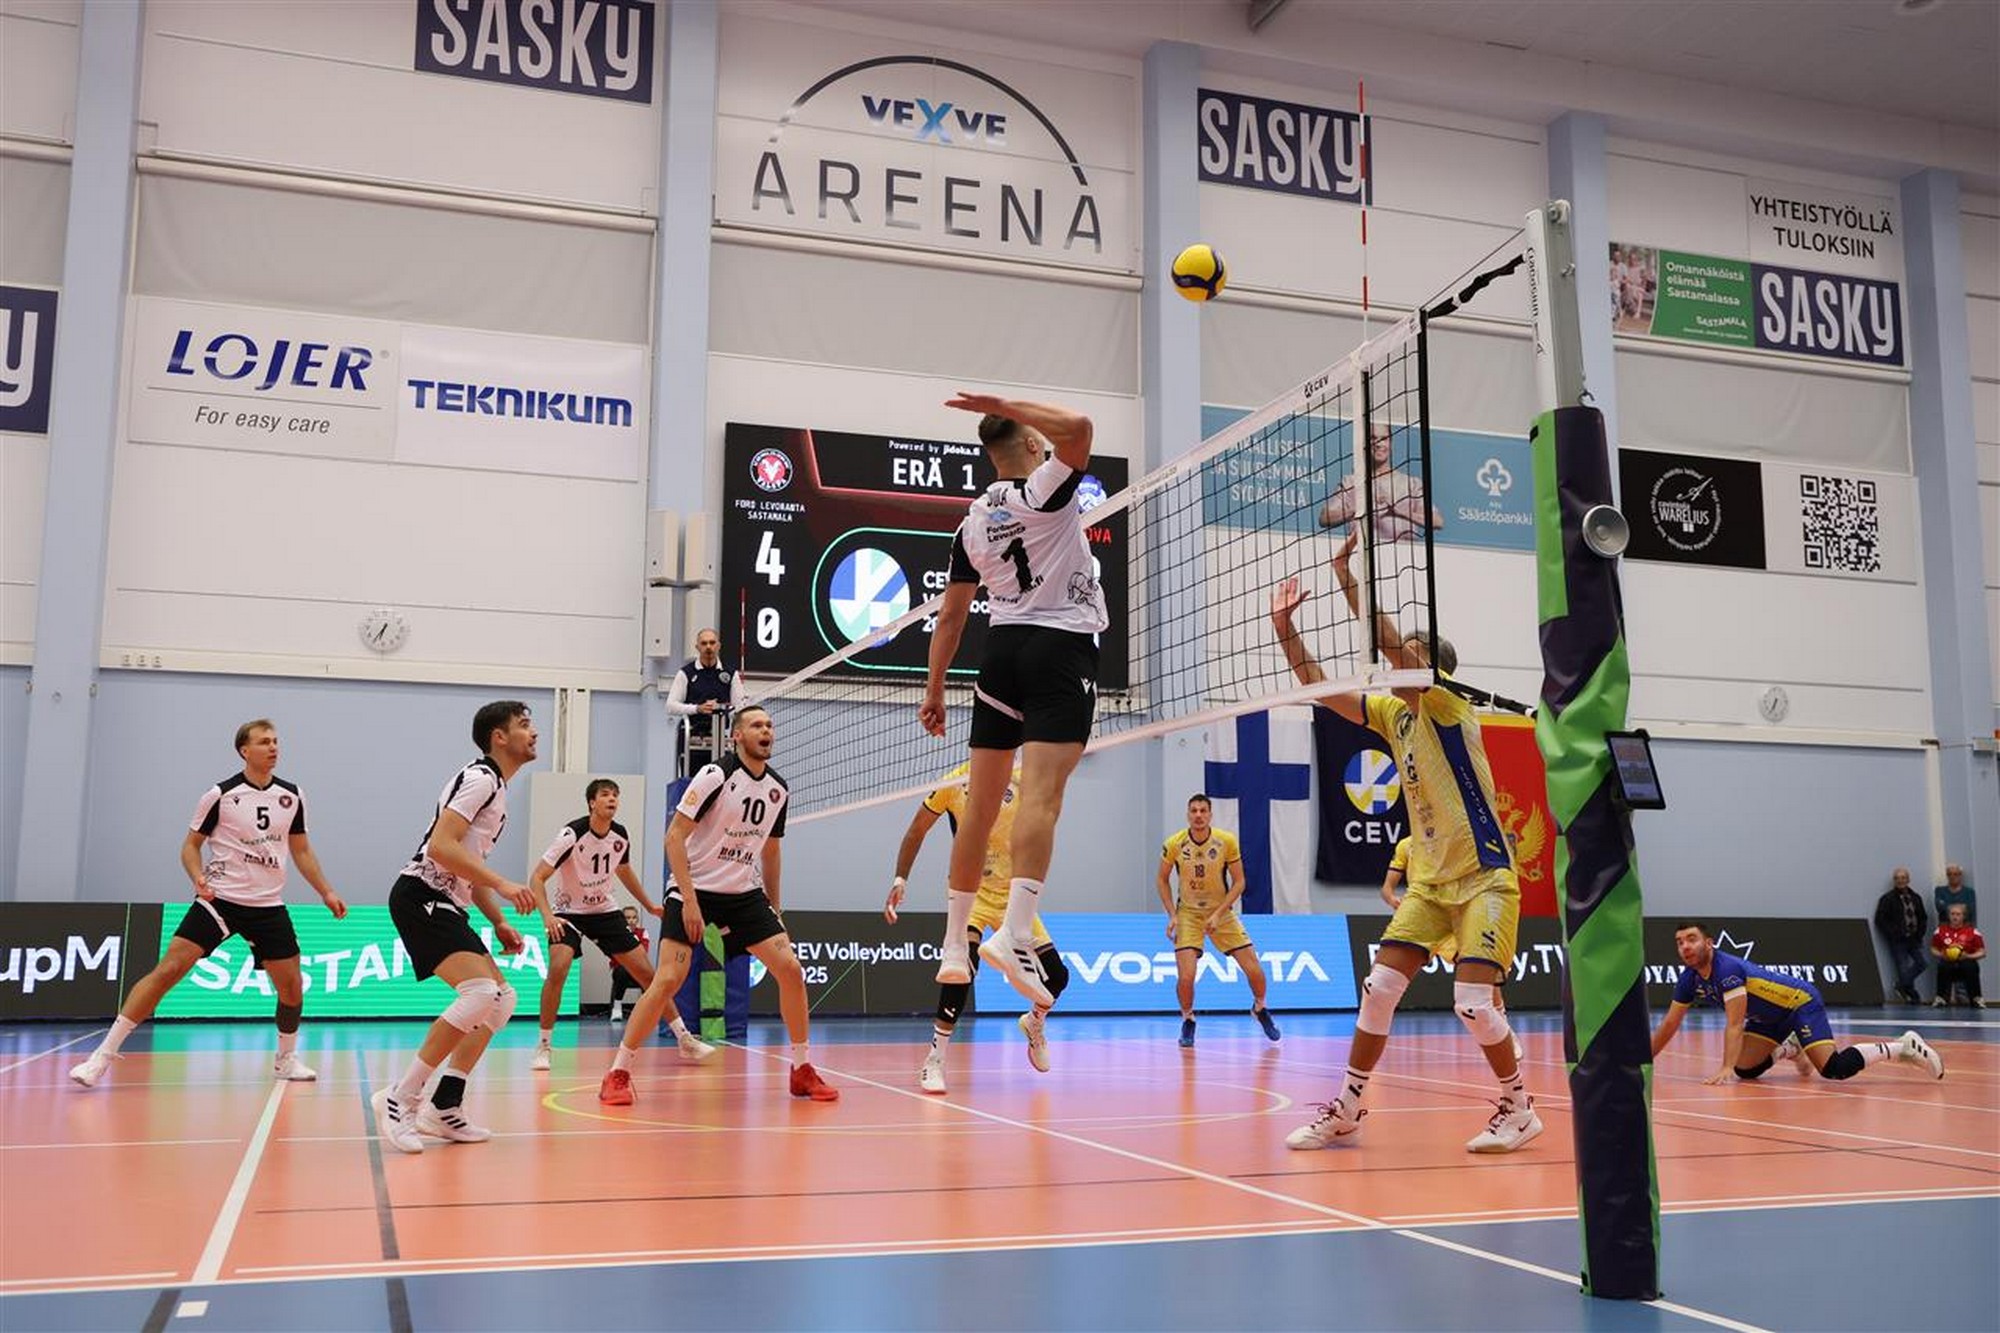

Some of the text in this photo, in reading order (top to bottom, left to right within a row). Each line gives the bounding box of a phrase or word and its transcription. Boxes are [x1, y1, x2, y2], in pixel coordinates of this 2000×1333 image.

[861, 94, 1006, 143] VEXVE
[1201, 97, 1364, 194] SASKY
[752, 151, 1101, 253] AREENA
[1750, 195, 1893, 235] YHTEISTYÖLLÄ
[1773, 227, 1875, 259] TULOKSIIN
[1667, 287, 1741, 306] Sastamalassa
[1696, 316, 1748, 328] SASTAMALA
[1760, 271, 1895, 357] SASKY
[166, 330, 373, 391] LOJER
[408, 379, 632, 427] TEKNIKUM
[195, 405, 330, 434] For easy care
[889, 440, 924, 453] Powered
[929, 444, 939, 454] by
[893, 456, 976, 490] ERÄ 1
[735, 499, 805, 513] FORD LEVORANTA
[748, 511, 792, 522] SASTAMALA
[1458, 507, 1533, 525] Säästöpankki
[1659, 506, 1710, 525] WARELIUS
[755, 530, 785, 586] 4
[1001, 537, 1032, 593] 1
[757, 607, 780, 649] 0
[257, 806, 270, 830] 5
[742, 797, 766, 825] 10
[1344, 821, 1400, 845] CEV
[592, 853, 610, 874] 11
[825, 941, 914, 964] Volleyball
[919, 943, 944, 960] Cu
[1823, 965, 1849, 983] OY
